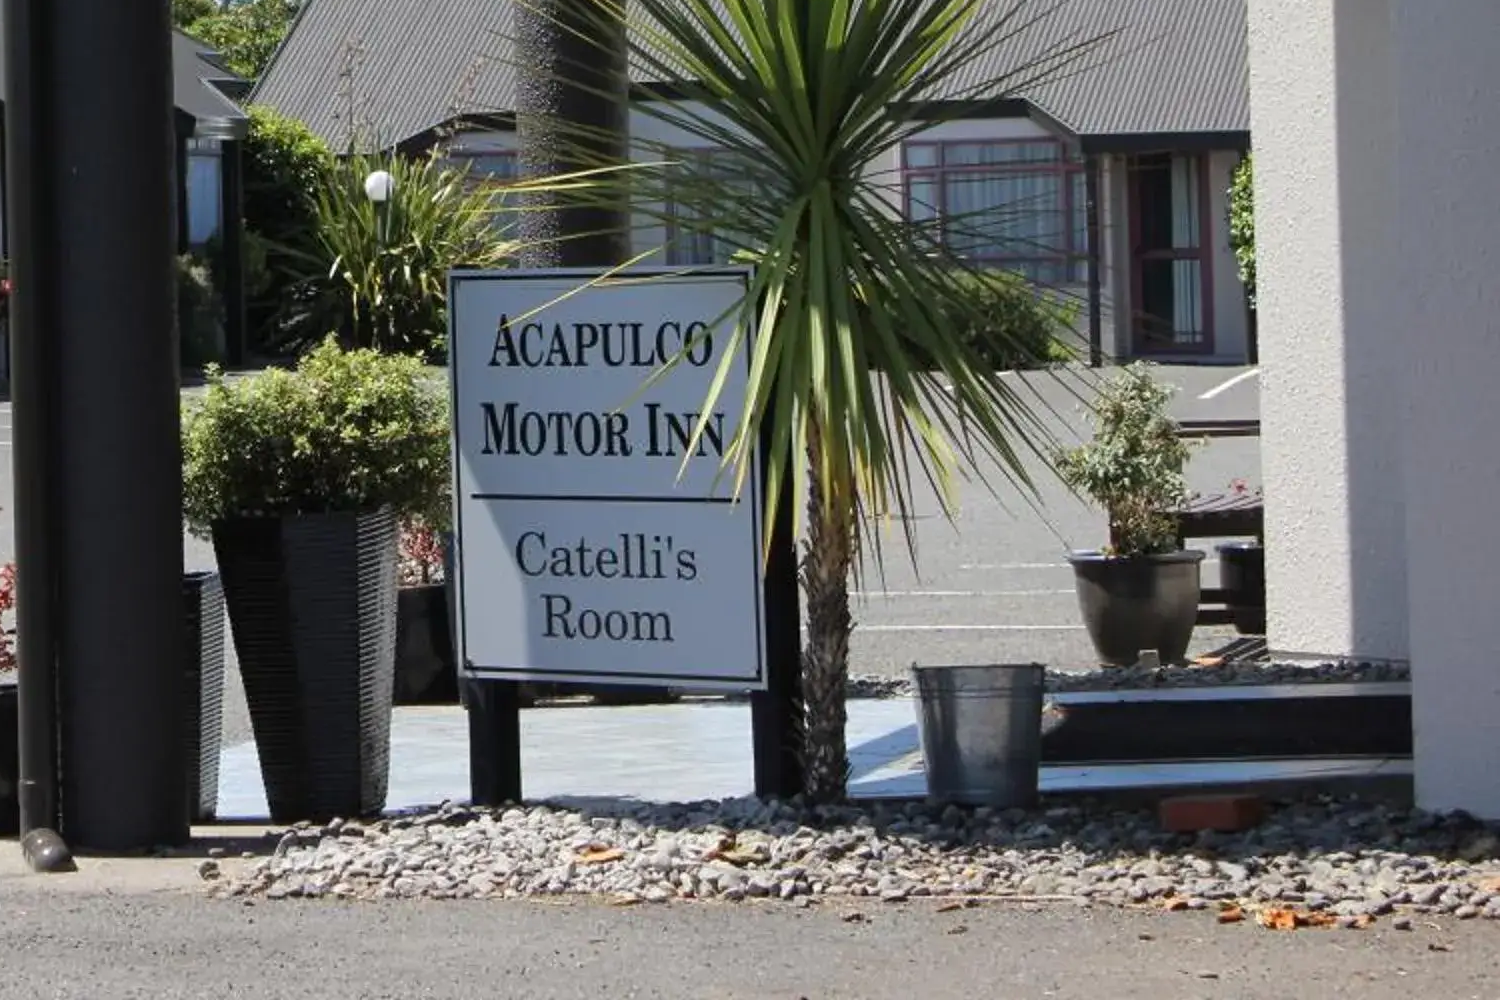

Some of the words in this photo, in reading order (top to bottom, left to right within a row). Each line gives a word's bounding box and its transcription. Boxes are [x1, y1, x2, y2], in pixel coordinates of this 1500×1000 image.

[487, 313, 714, 368] ACAPULCO
[480, 402, 633, 458] MOTOR
[643, 402, 726, 459] INN
[514, 530, 698, 581] Catelli's
[541, 594, 675, 643] Room
